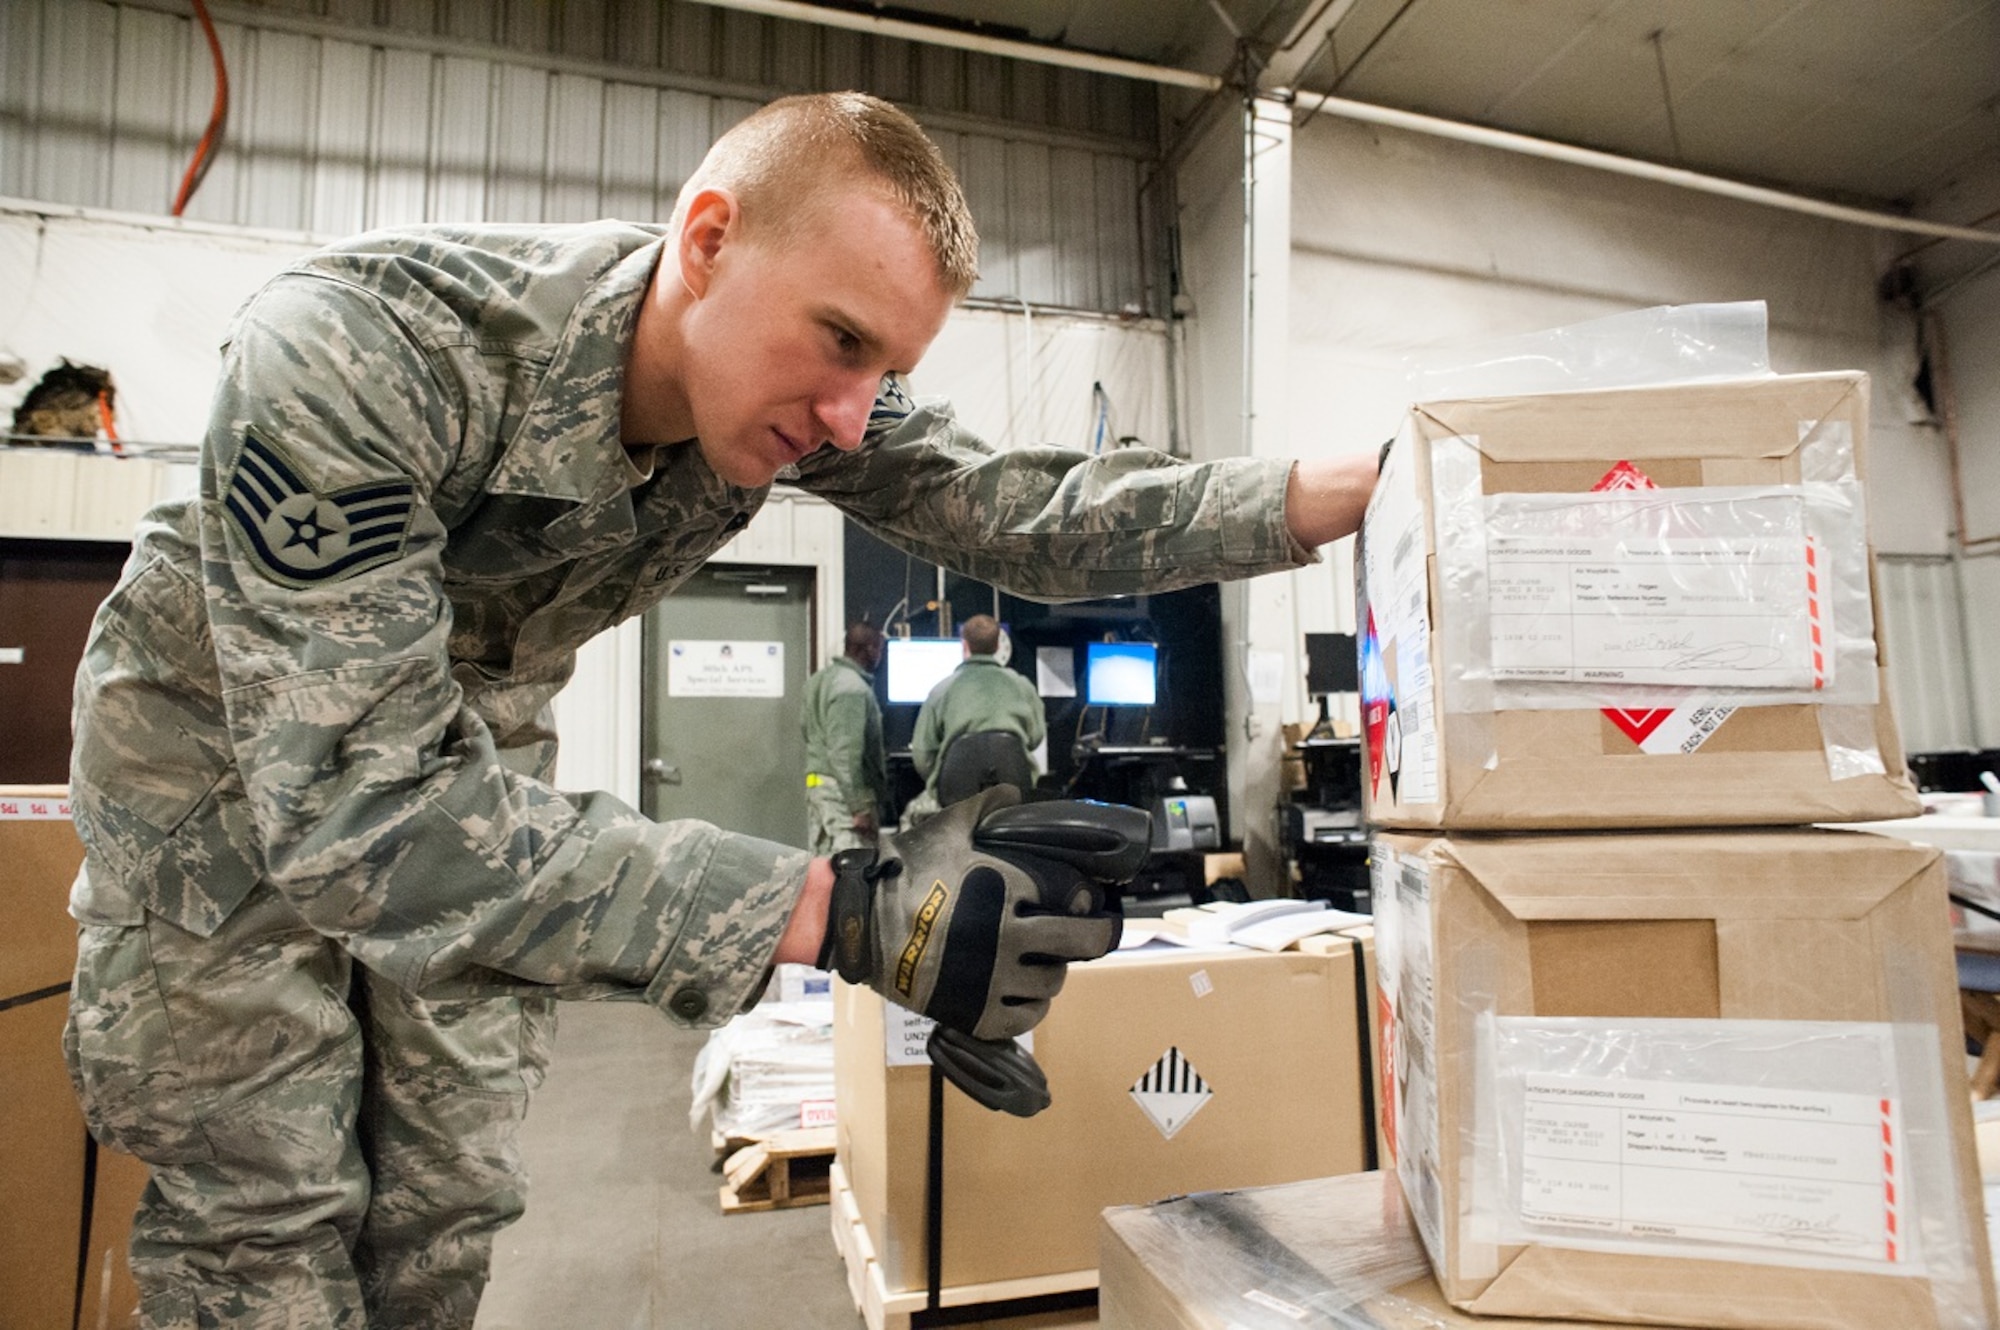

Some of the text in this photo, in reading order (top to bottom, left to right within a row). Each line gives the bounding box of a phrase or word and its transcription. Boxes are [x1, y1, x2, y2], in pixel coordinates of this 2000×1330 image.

[1520, 549, 1564, 557] DANGEROUS
[1566, 549, 1592, 557] GOODS
[1576, 583, 1592, 591] Page
[1638, 583, 1658, 591] Pages
[1607, 594, 1639, 602] Reference
[1641, 594, 1667, 602] Number
[1583, 671, 1624, 679] WARNING
[1680, 730, 1704, 754] EACH
[1700, 716, 1718, 733] NOT
[898, 889, 944, 991] WARRIOR
[1567, 1089, 1615, 1099] DANGEROUS
[1617, 1092, 1645, 1100] GOODS
[1627, 1129, 1645, 1138] Page
[1695, 1134, 1717, 1142] Pages
[1660, 1145, 1696, 1154] Reference
[1698, 1147, 1726, 1156] Number
[1632, 1225, 1677, 1235] WARNING
